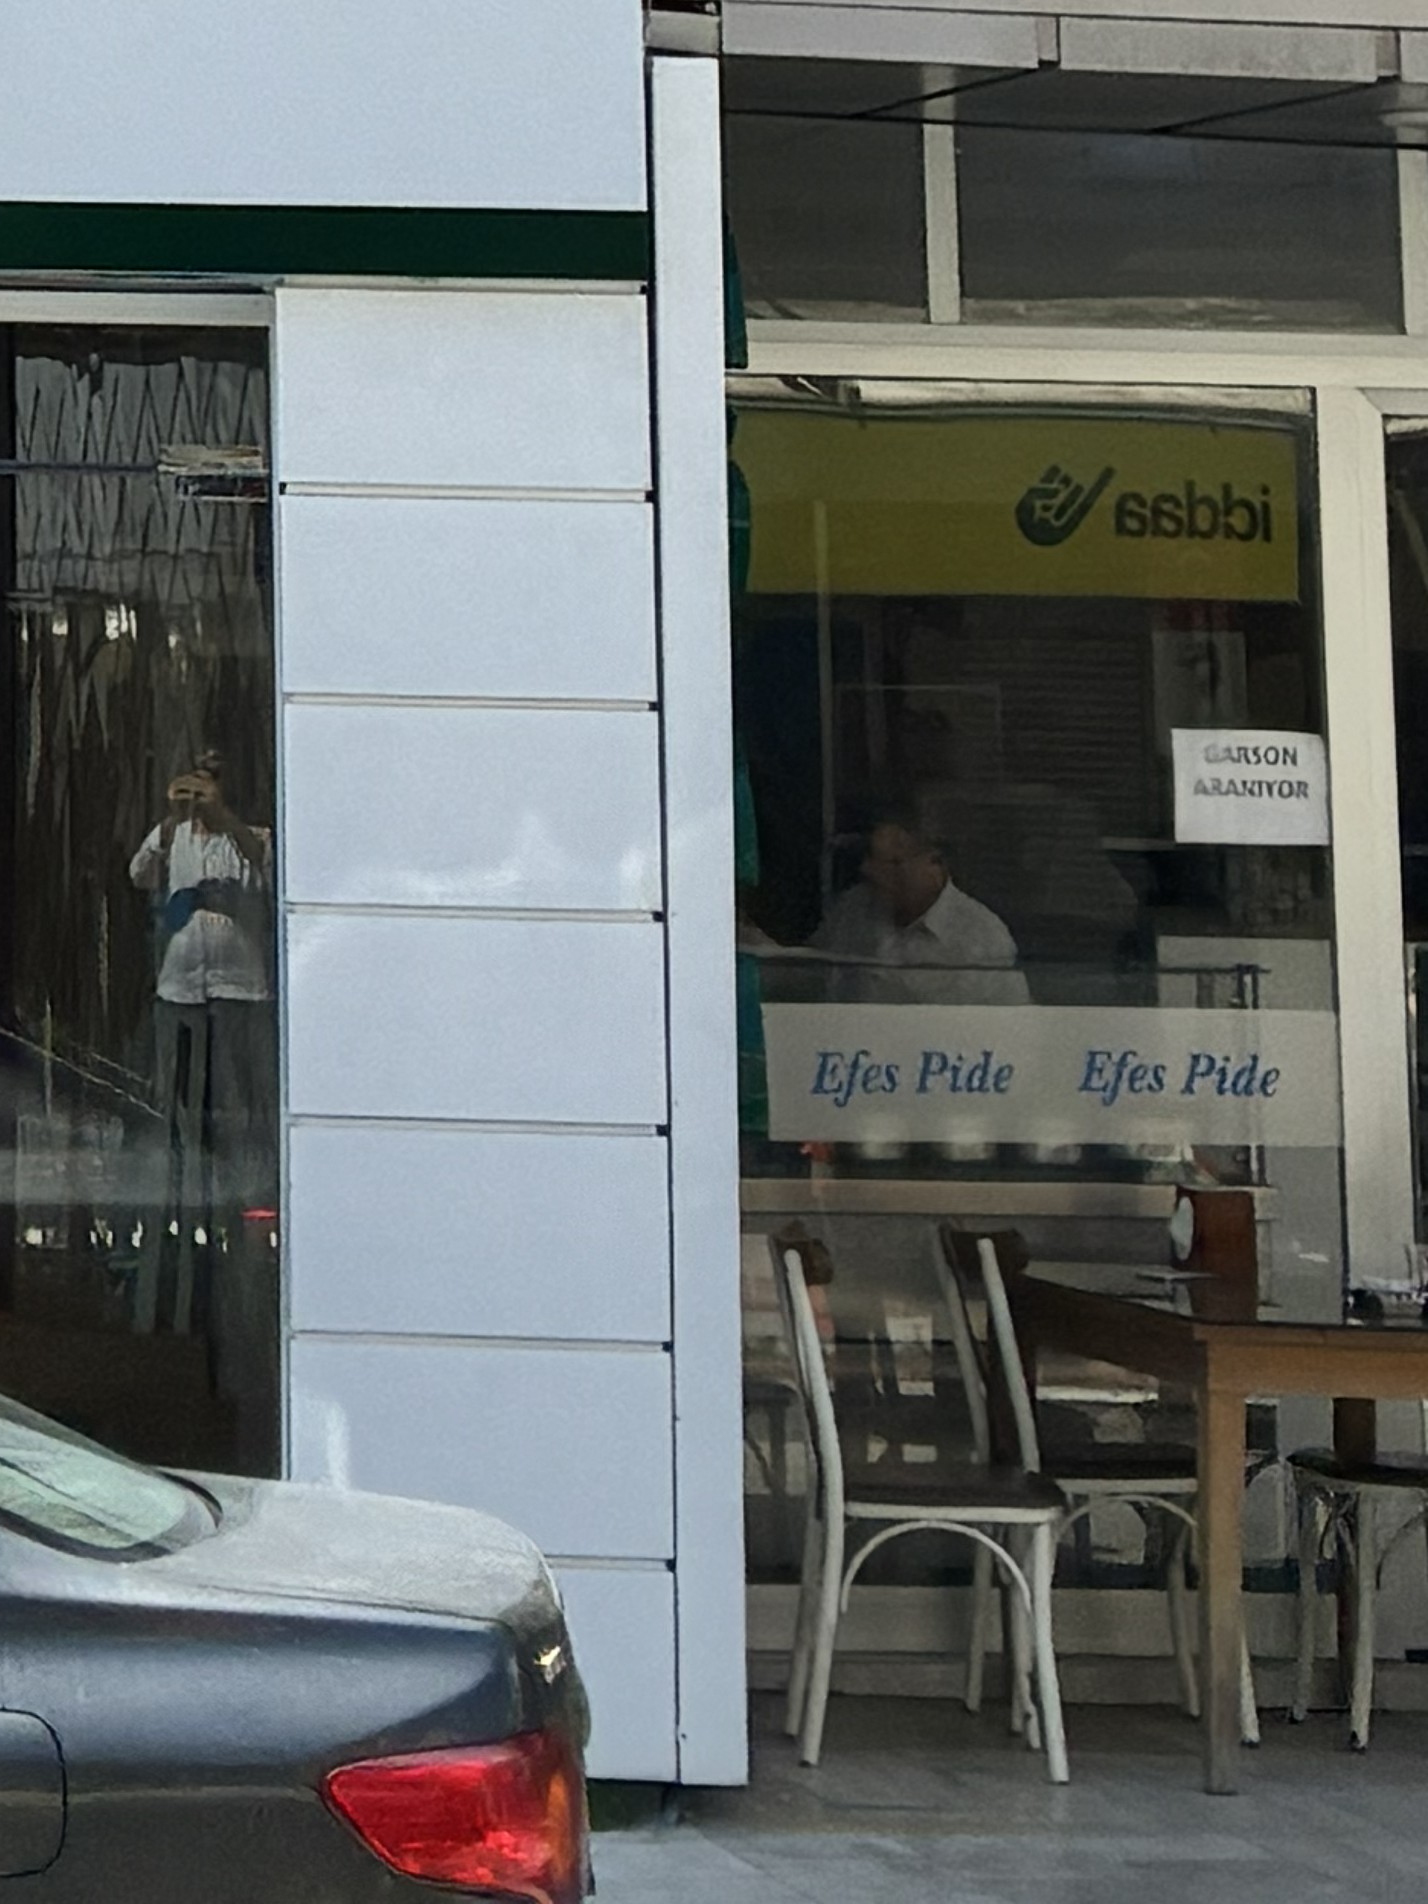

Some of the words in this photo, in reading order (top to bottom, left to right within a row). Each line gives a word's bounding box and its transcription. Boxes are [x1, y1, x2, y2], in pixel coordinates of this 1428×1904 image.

[810, 1049, 901, 1108] Efes
[915, 1049, 1016, 1096] Pide
[1078, 1049, 1168, 1106] Efes
[1180, 1052, 1282, 1099] Pide
